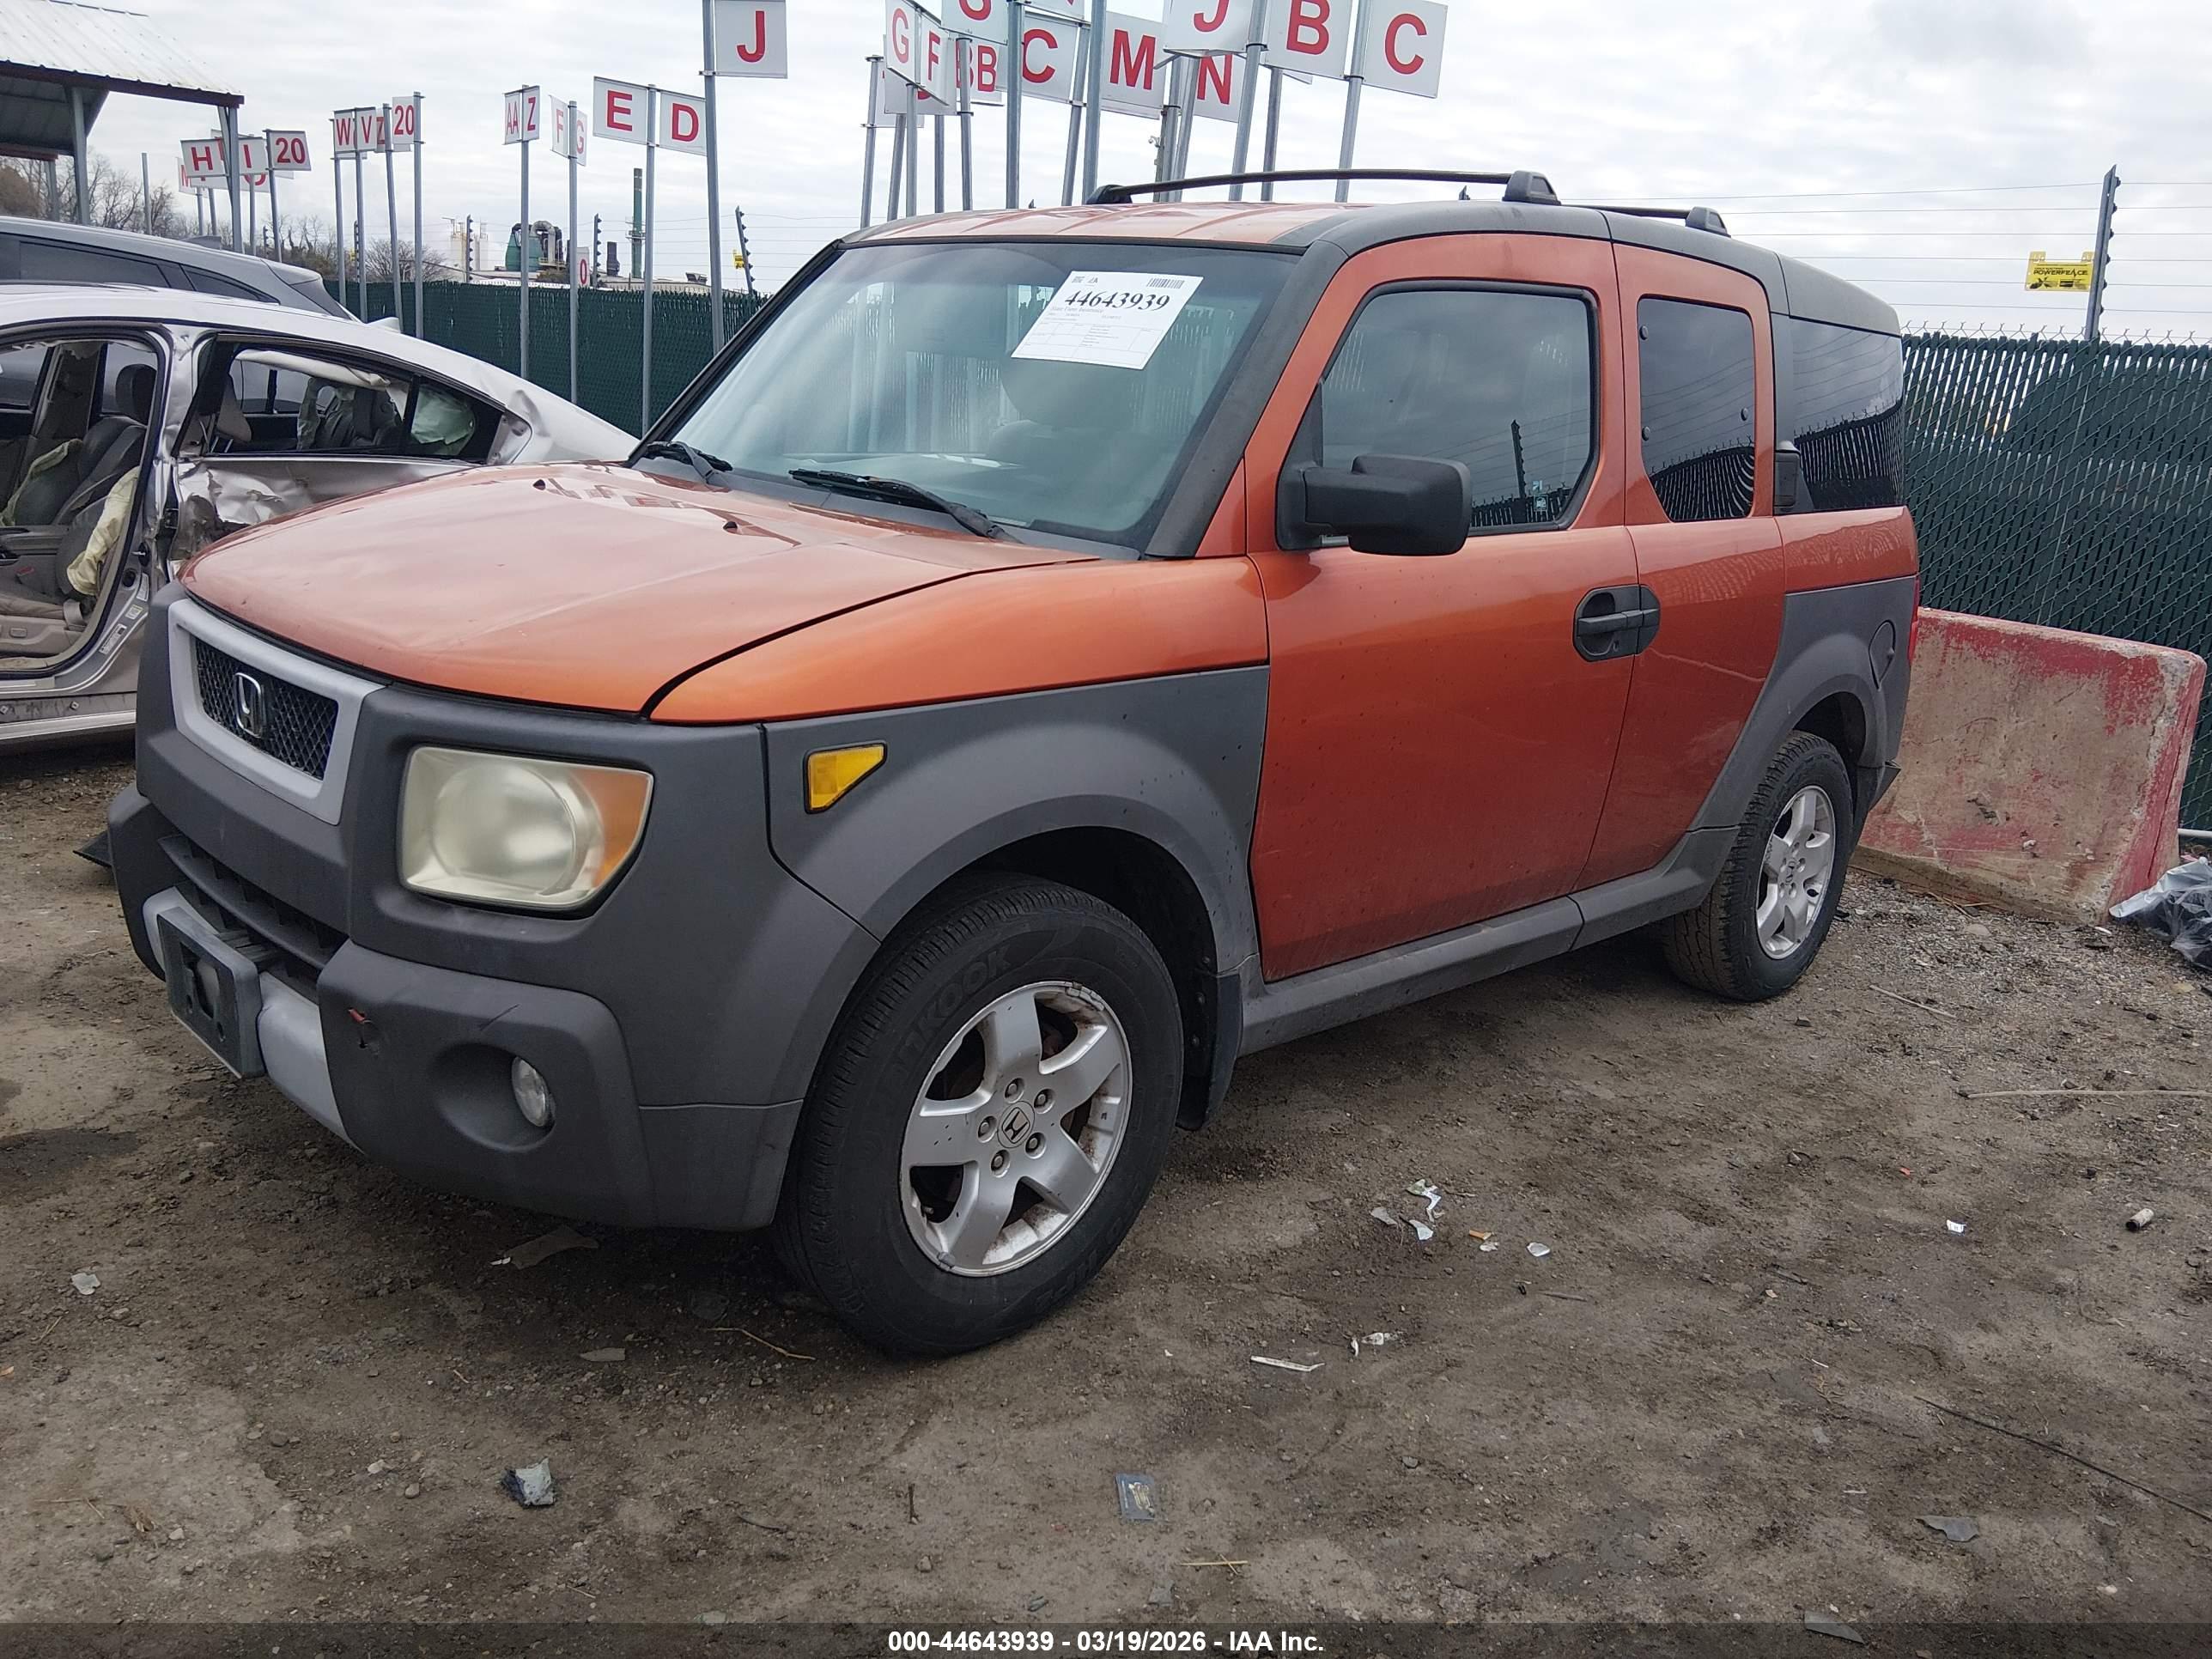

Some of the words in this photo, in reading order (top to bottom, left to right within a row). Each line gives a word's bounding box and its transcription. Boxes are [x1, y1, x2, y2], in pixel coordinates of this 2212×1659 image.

[736, 9, 766, 63] J
[892, 8, 909, 64] G
[1286, 0, 1330, 55] B
[1384, 13, 1427, 75] C
[927, 30, 941, 82] F
[1022, 28, 1059, 83] C
[1110, 28, 1156, 90] M
[1196, 53, 1233, 105] N
[393, 105, 414, 136] 20
[506, 100, 520, 136] AA
[527, 96, 537, 131] Z
[556, 108, 563, 143] F
[606, 89, 633, 131] E
[671, 102, 699, 143] D
[336, 118, 351, 146] W
[362, 115, 372, 144] V
[191, 146, 213, 171] H
[243, 144, 252, 168] I
[276, 137, 306, 164] 20
[1065, 289, 1170, 312] 44643939
